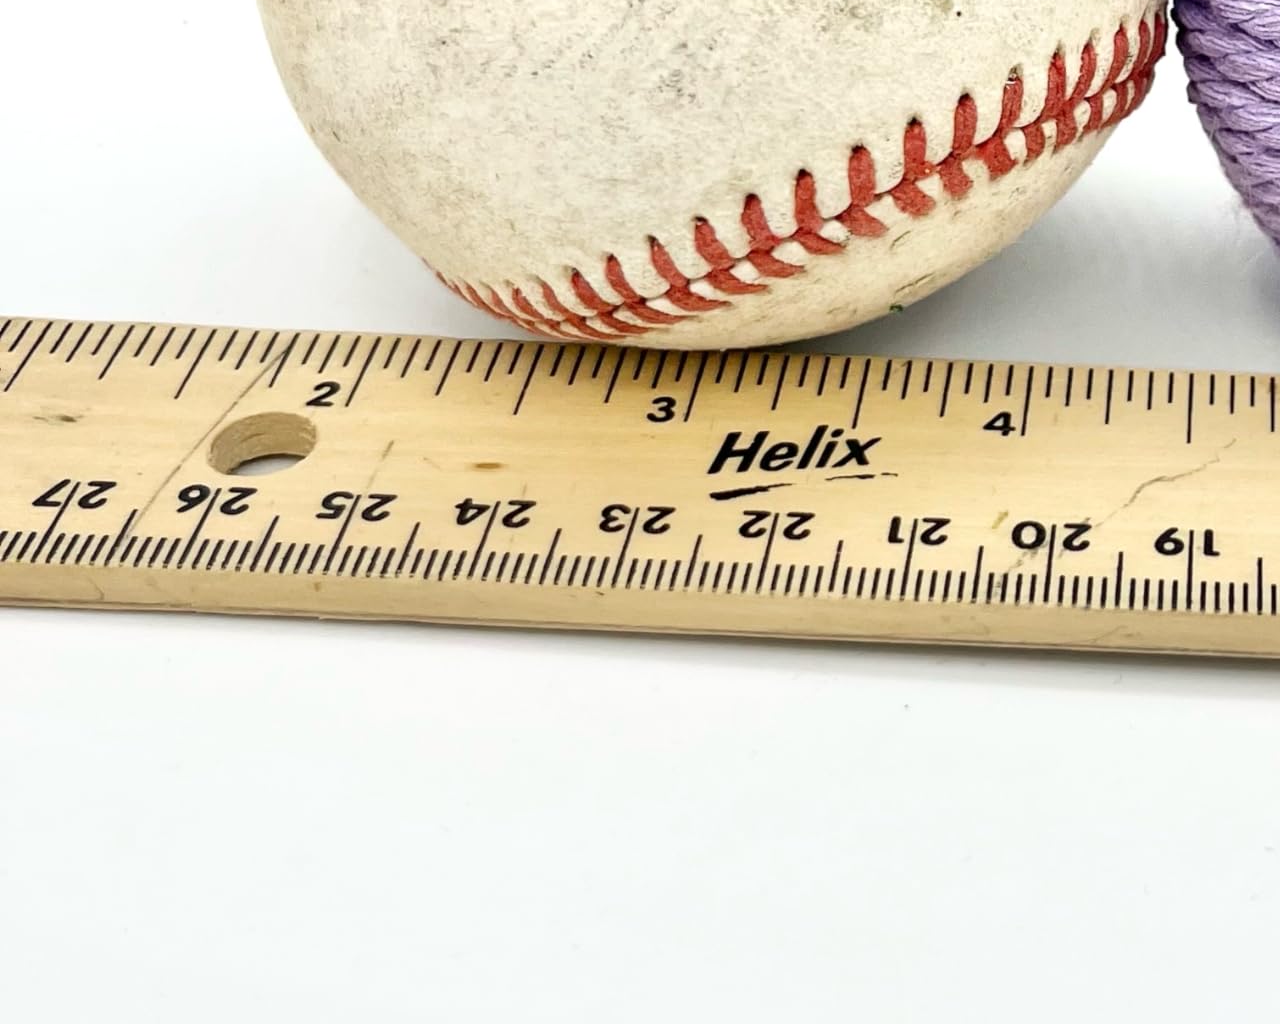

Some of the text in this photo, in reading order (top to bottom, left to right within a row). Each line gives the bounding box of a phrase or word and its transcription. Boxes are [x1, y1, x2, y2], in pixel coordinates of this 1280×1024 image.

[306, 381, 341, 407] 2
[646, 396, 676, 422] 3
[983, 412, 1016, 436] 4
[707, 424, 882, 474] Helix
